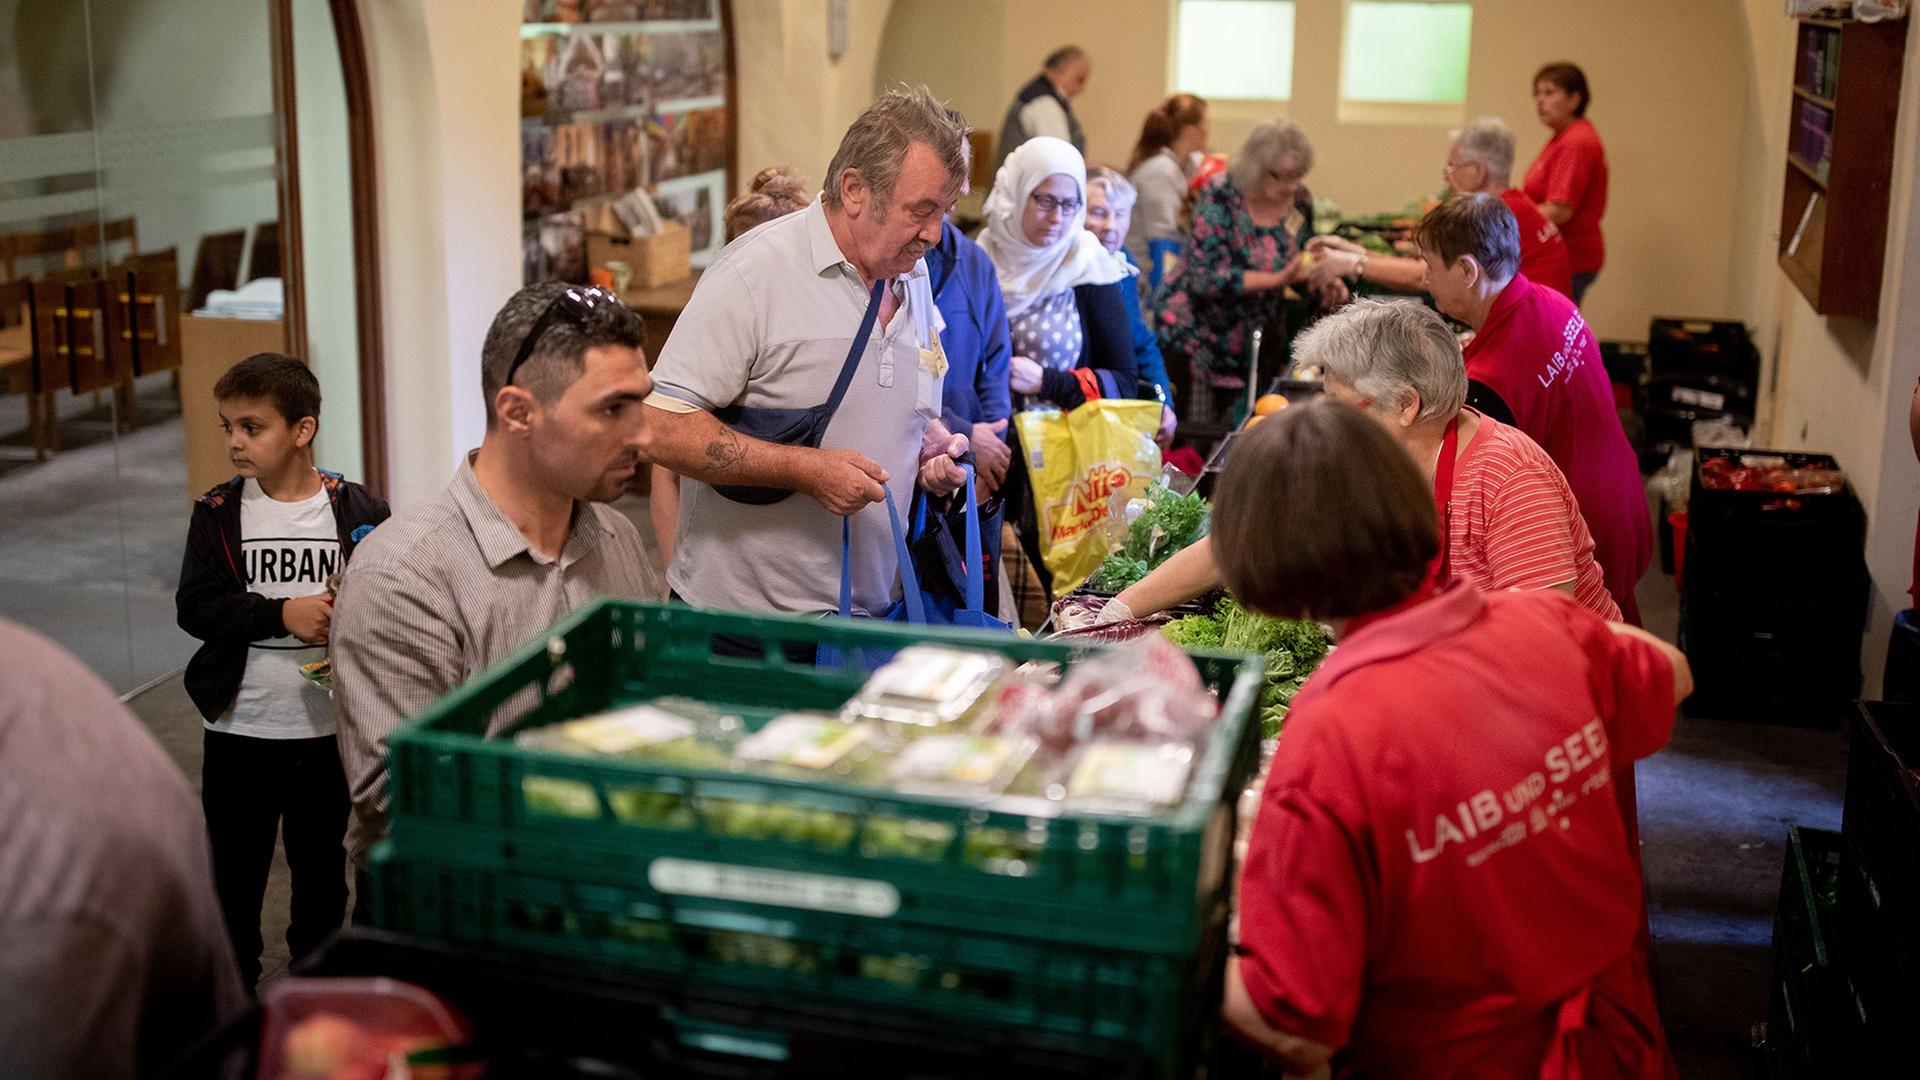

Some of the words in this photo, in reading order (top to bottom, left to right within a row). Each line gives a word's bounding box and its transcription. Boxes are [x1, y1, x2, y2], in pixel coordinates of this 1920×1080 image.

[1537, 351, 1566, 388] LAIB
[1072, 464, 1132, 516] Ntto
[242, 548, 336, 585] URBAN
[1405, 788, 1504, 865] LAIB
[1544, 716, 1608, 784] SEE
